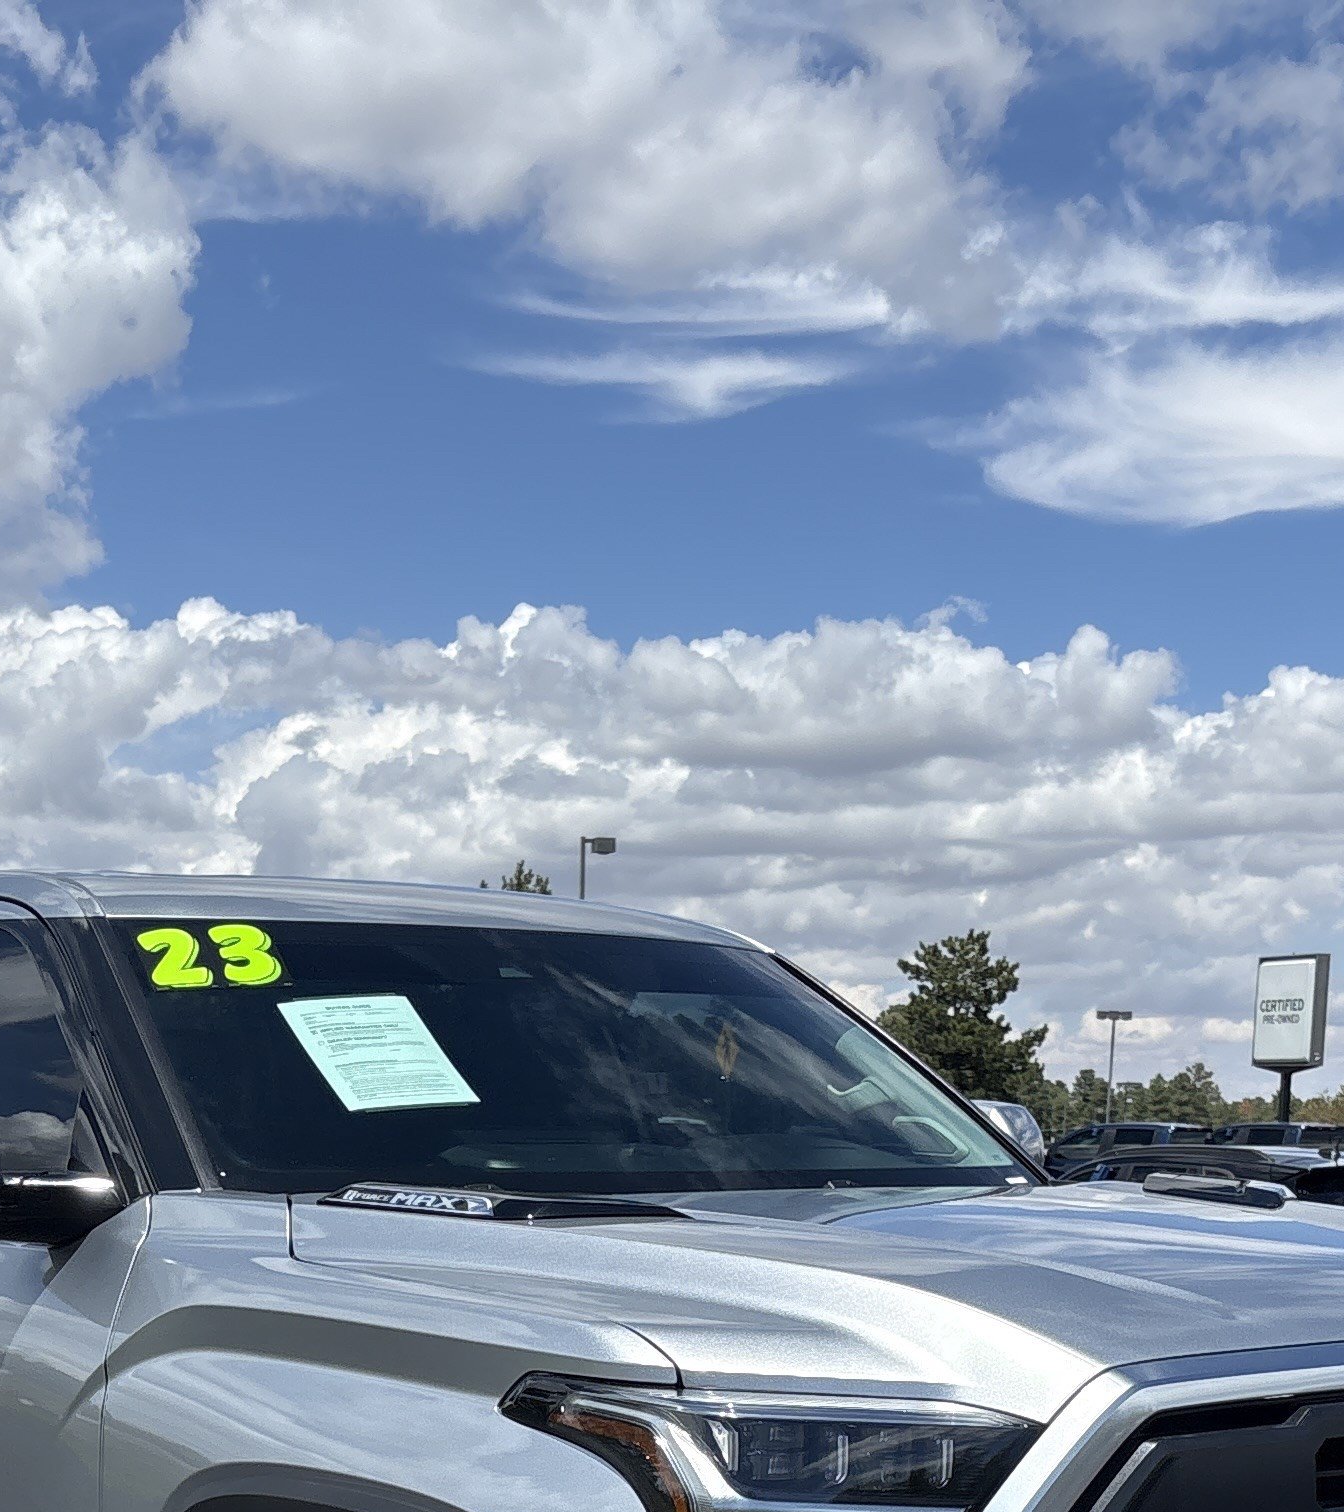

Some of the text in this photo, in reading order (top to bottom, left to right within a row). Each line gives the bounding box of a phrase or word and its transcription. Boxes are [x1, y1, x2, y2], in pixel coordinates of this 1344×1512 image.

[136, 924, 282, 988] 23
[1259, 998, 1305, 1012] CERTIFIED
[389, 1192, 460, 1210] MAX
